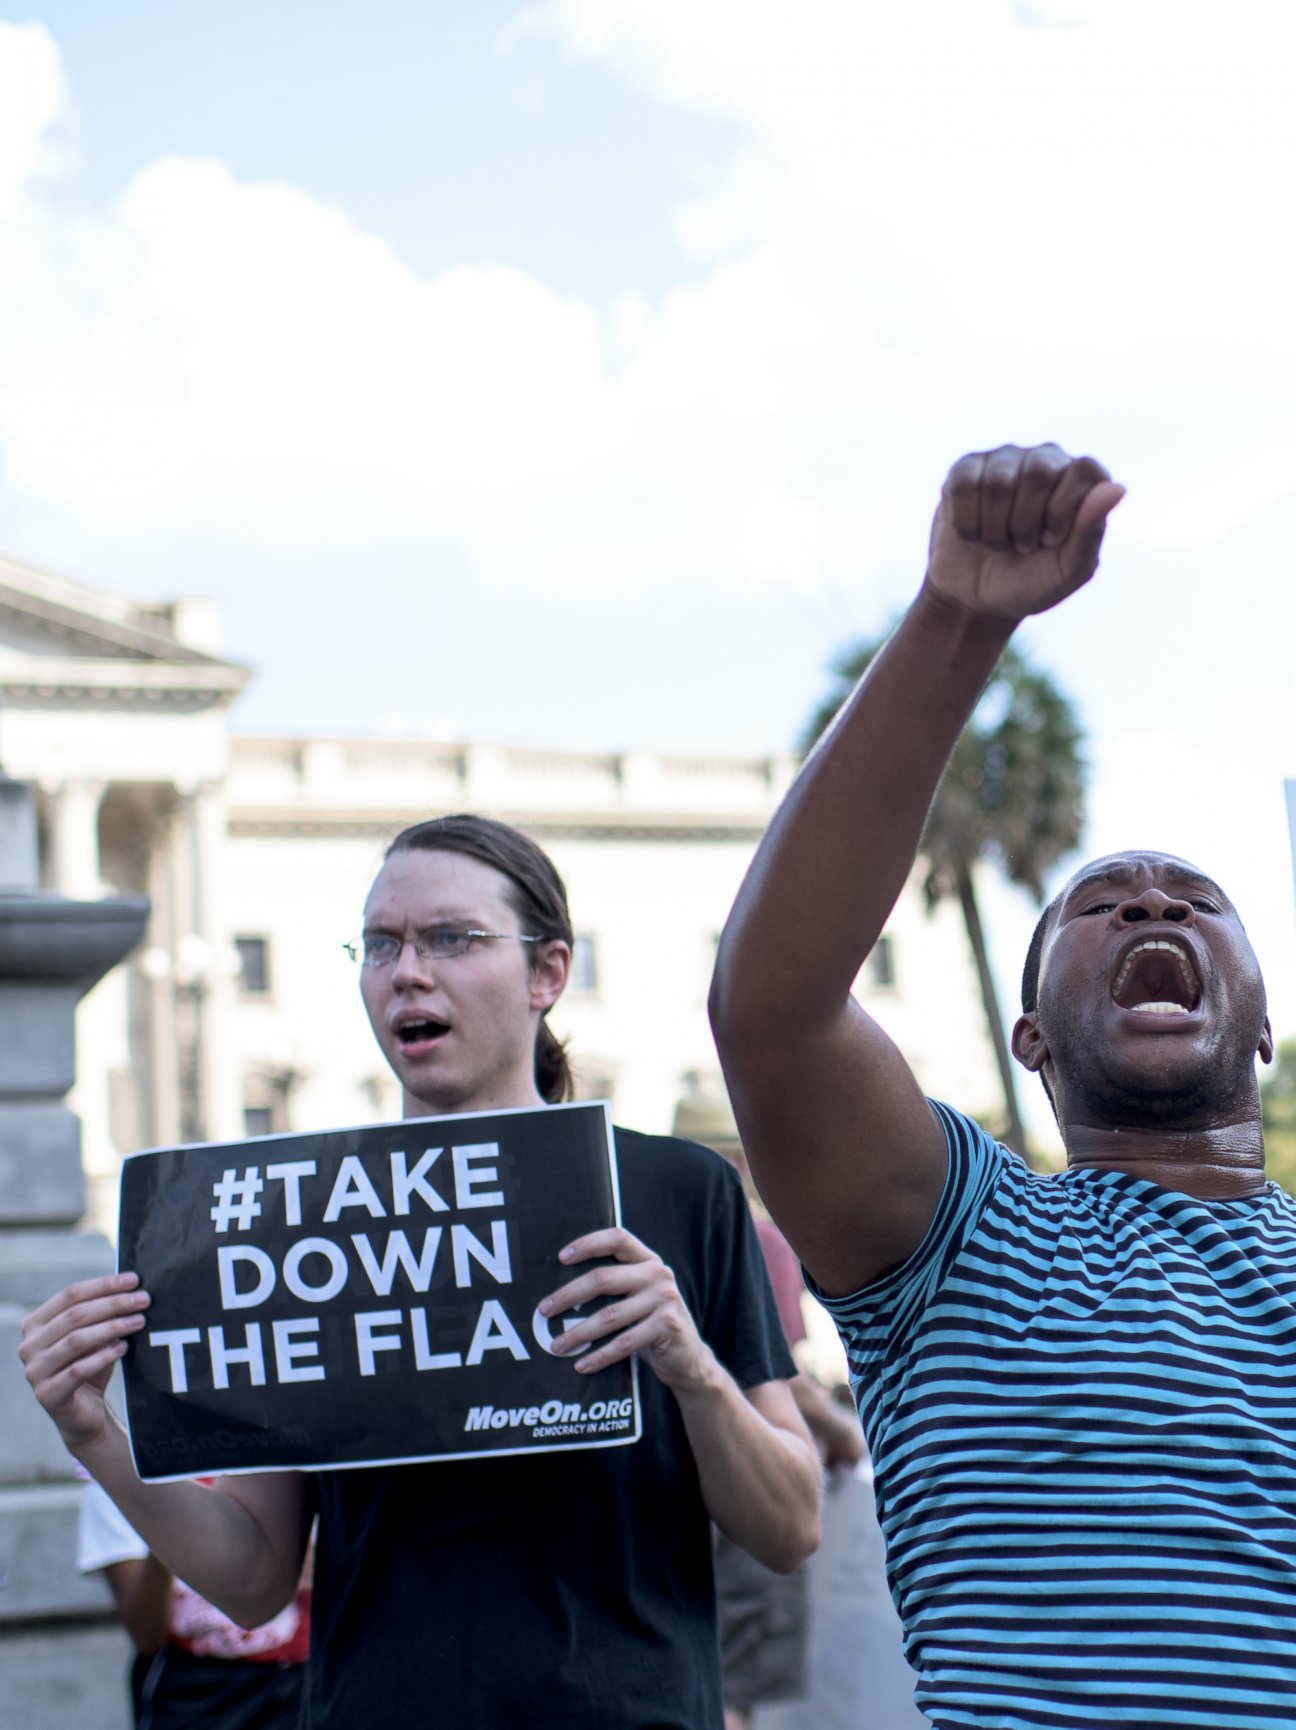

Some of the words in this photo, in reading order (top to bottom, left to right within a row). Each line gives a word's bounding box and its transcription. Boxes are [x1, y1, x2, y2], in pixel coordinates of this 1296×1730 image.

[210, 1142, 505, 1234] #TAKE
[215, 1219, 514, 1311] DOWN
[149, 1318, 327, 1394] THE
[532, 1422, 586, 1438] DEMOCRACY
[586, 1421, 598, 1433] IN
[599, 1418, 630, 1433] ACTION
